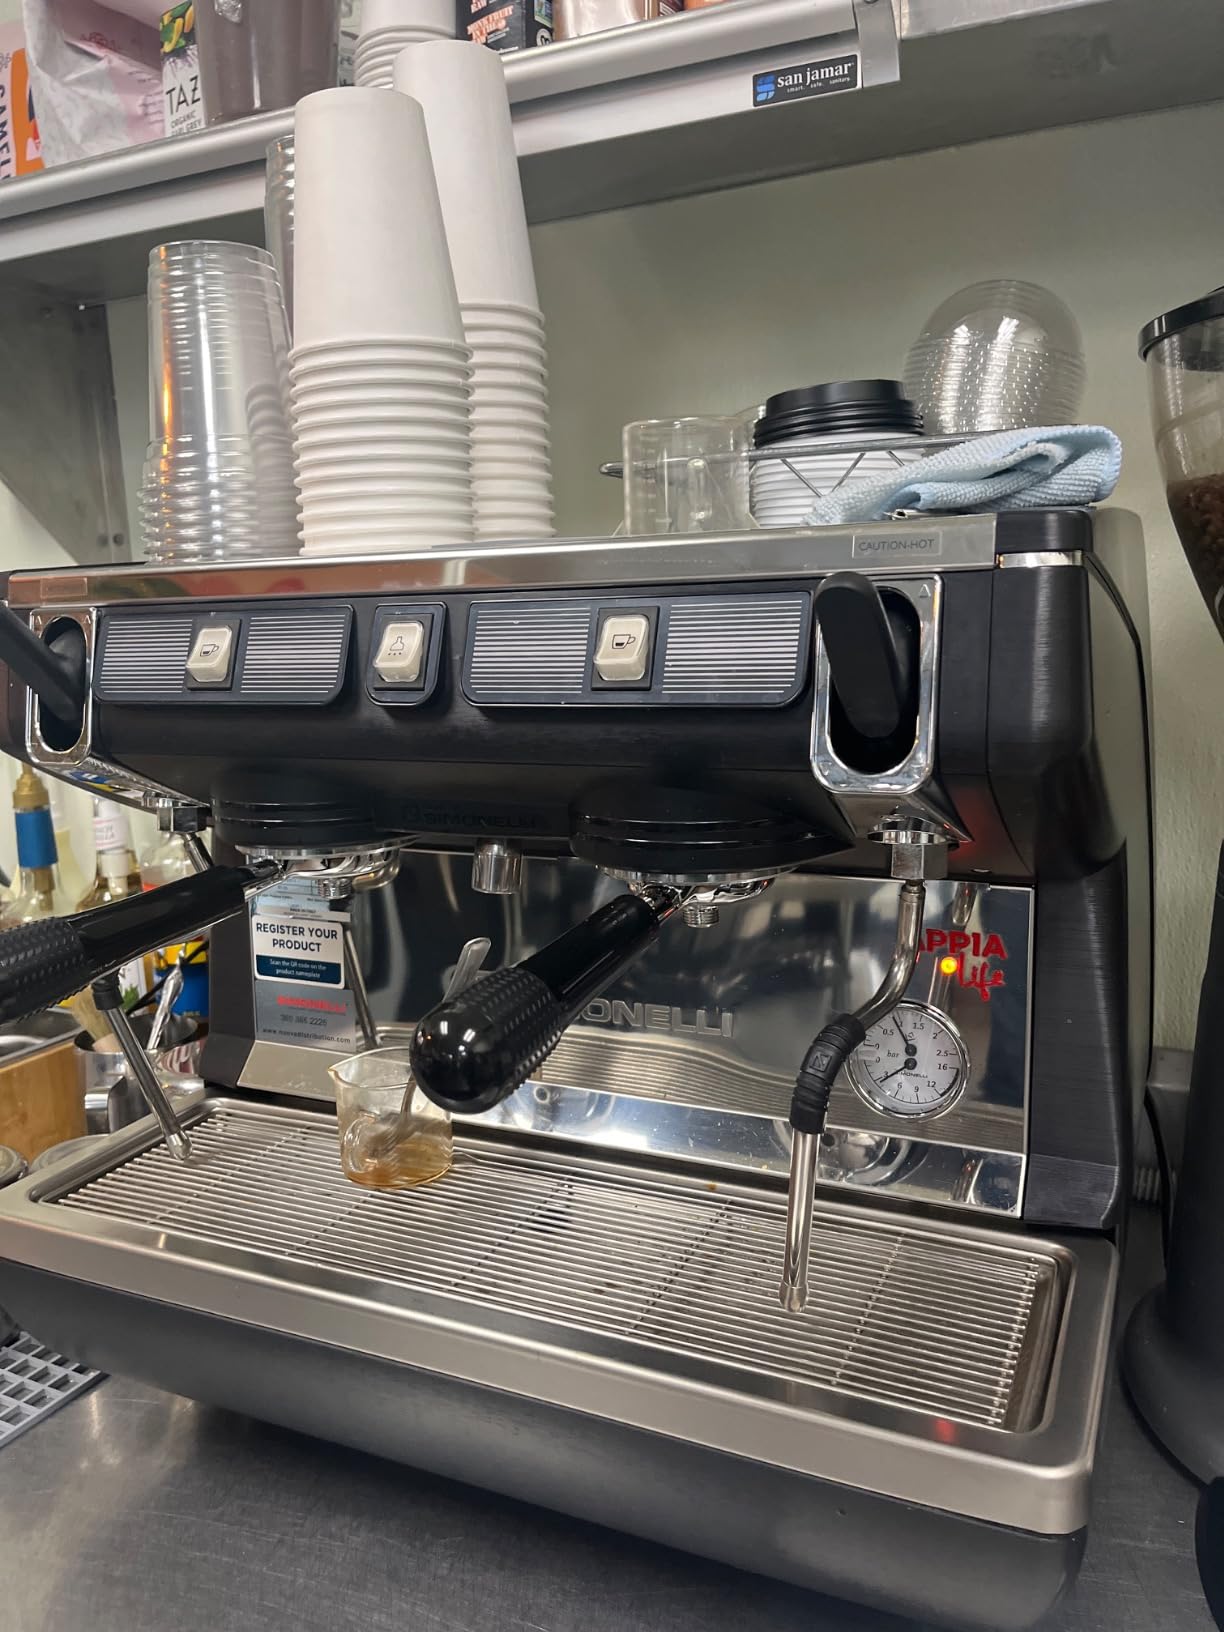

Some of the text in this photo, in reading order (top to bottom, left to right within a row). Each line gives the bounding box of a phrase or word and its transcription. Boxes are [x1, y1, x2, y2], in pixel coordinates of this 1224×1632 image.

[777, 63, 852, 88] san jamar
[858, 538, 935, 551] CAUTION-HOT
[256, 922, 338, 940] REGISTER YOUR
[272, 938, 322, 952] PRODUCT
[276, 968, 295, 976] product
[577, 998, 734, 1038] ONELLI
[913, 1022, 925, 1030] 1.5
[886, 1050, 899, 1058] bar
[914, 1085, 920, 1093] 9
[927, 1080, 937, 1088] 12
